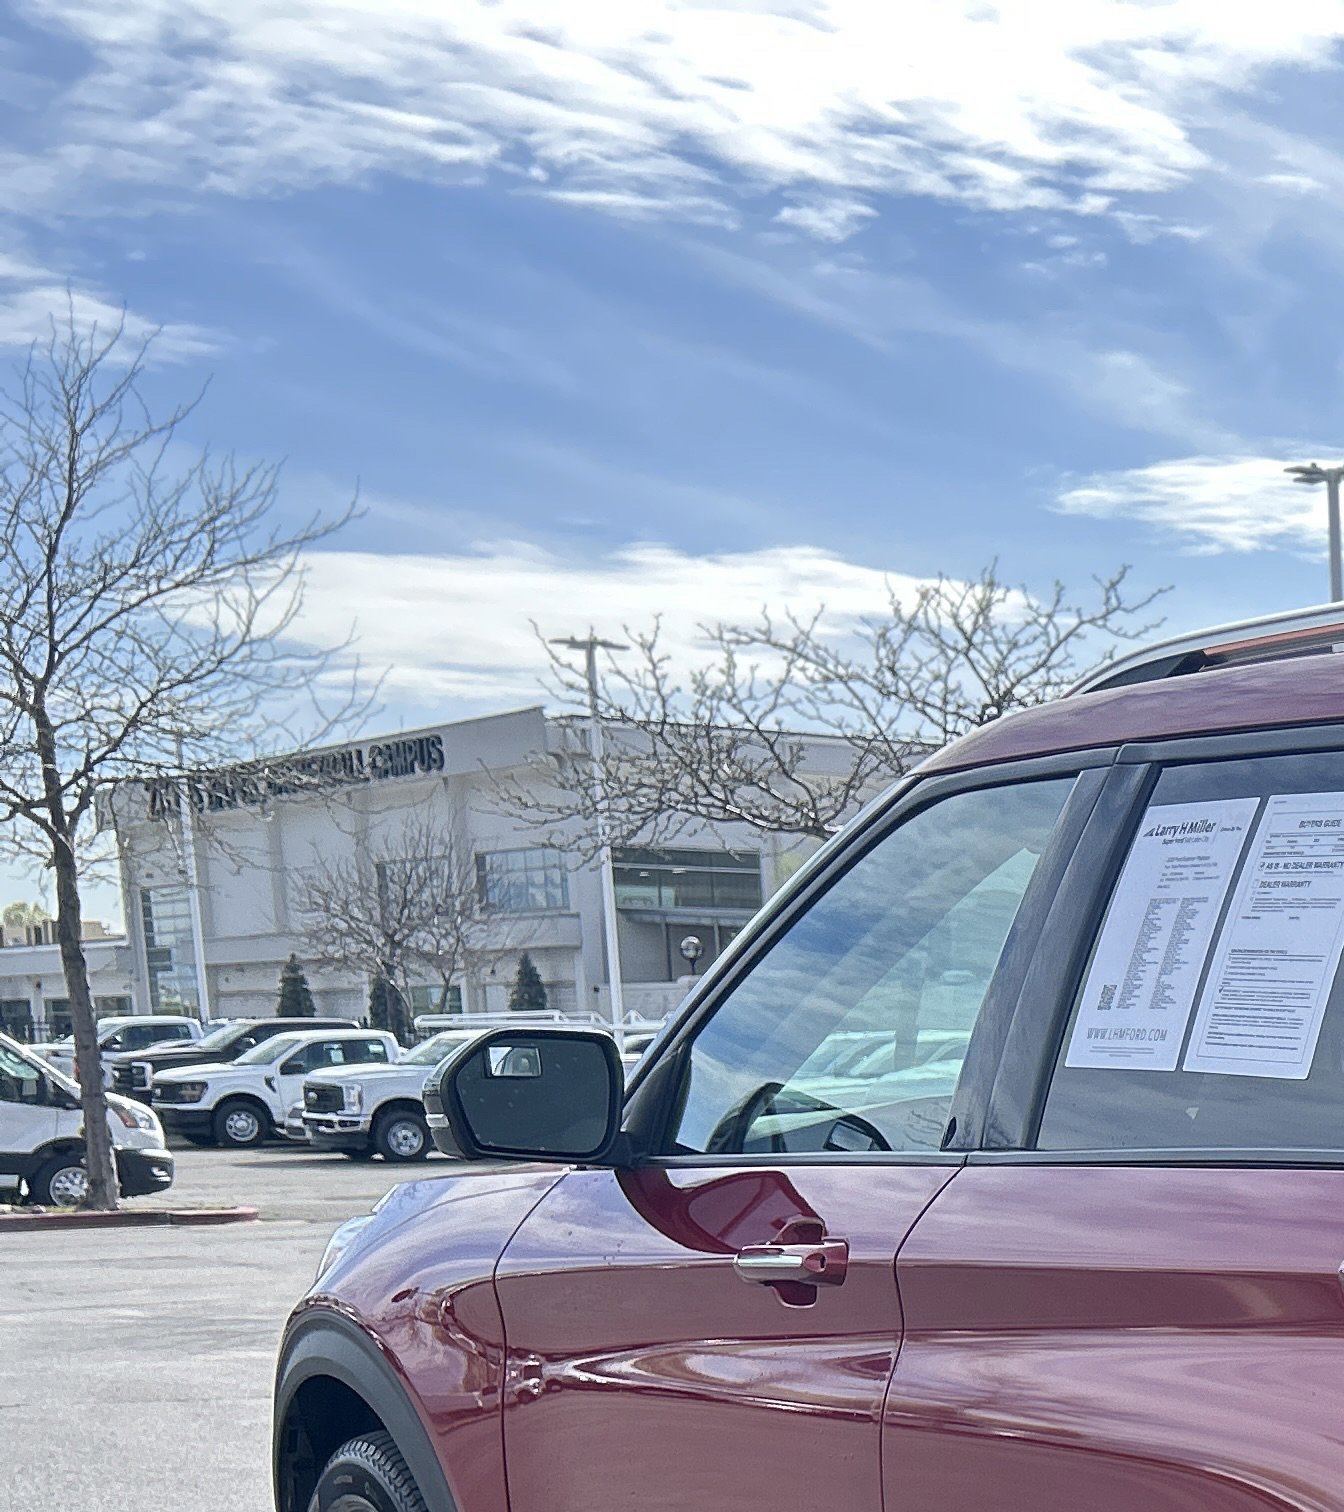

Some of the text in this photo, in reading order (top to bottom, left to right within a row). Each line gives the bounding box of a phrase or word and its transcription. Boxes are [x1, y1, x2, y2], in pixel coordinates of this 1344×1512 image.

[1154, 823, 1181, 838] Larry
[1187, 818, 1217, 835] Miller
[1265, 862, 1274, 870] AS
[1291, 861, 1314, 870] DEALER
[1086, 1027, 1169, 1042] WWW.LHMFORD.COM
